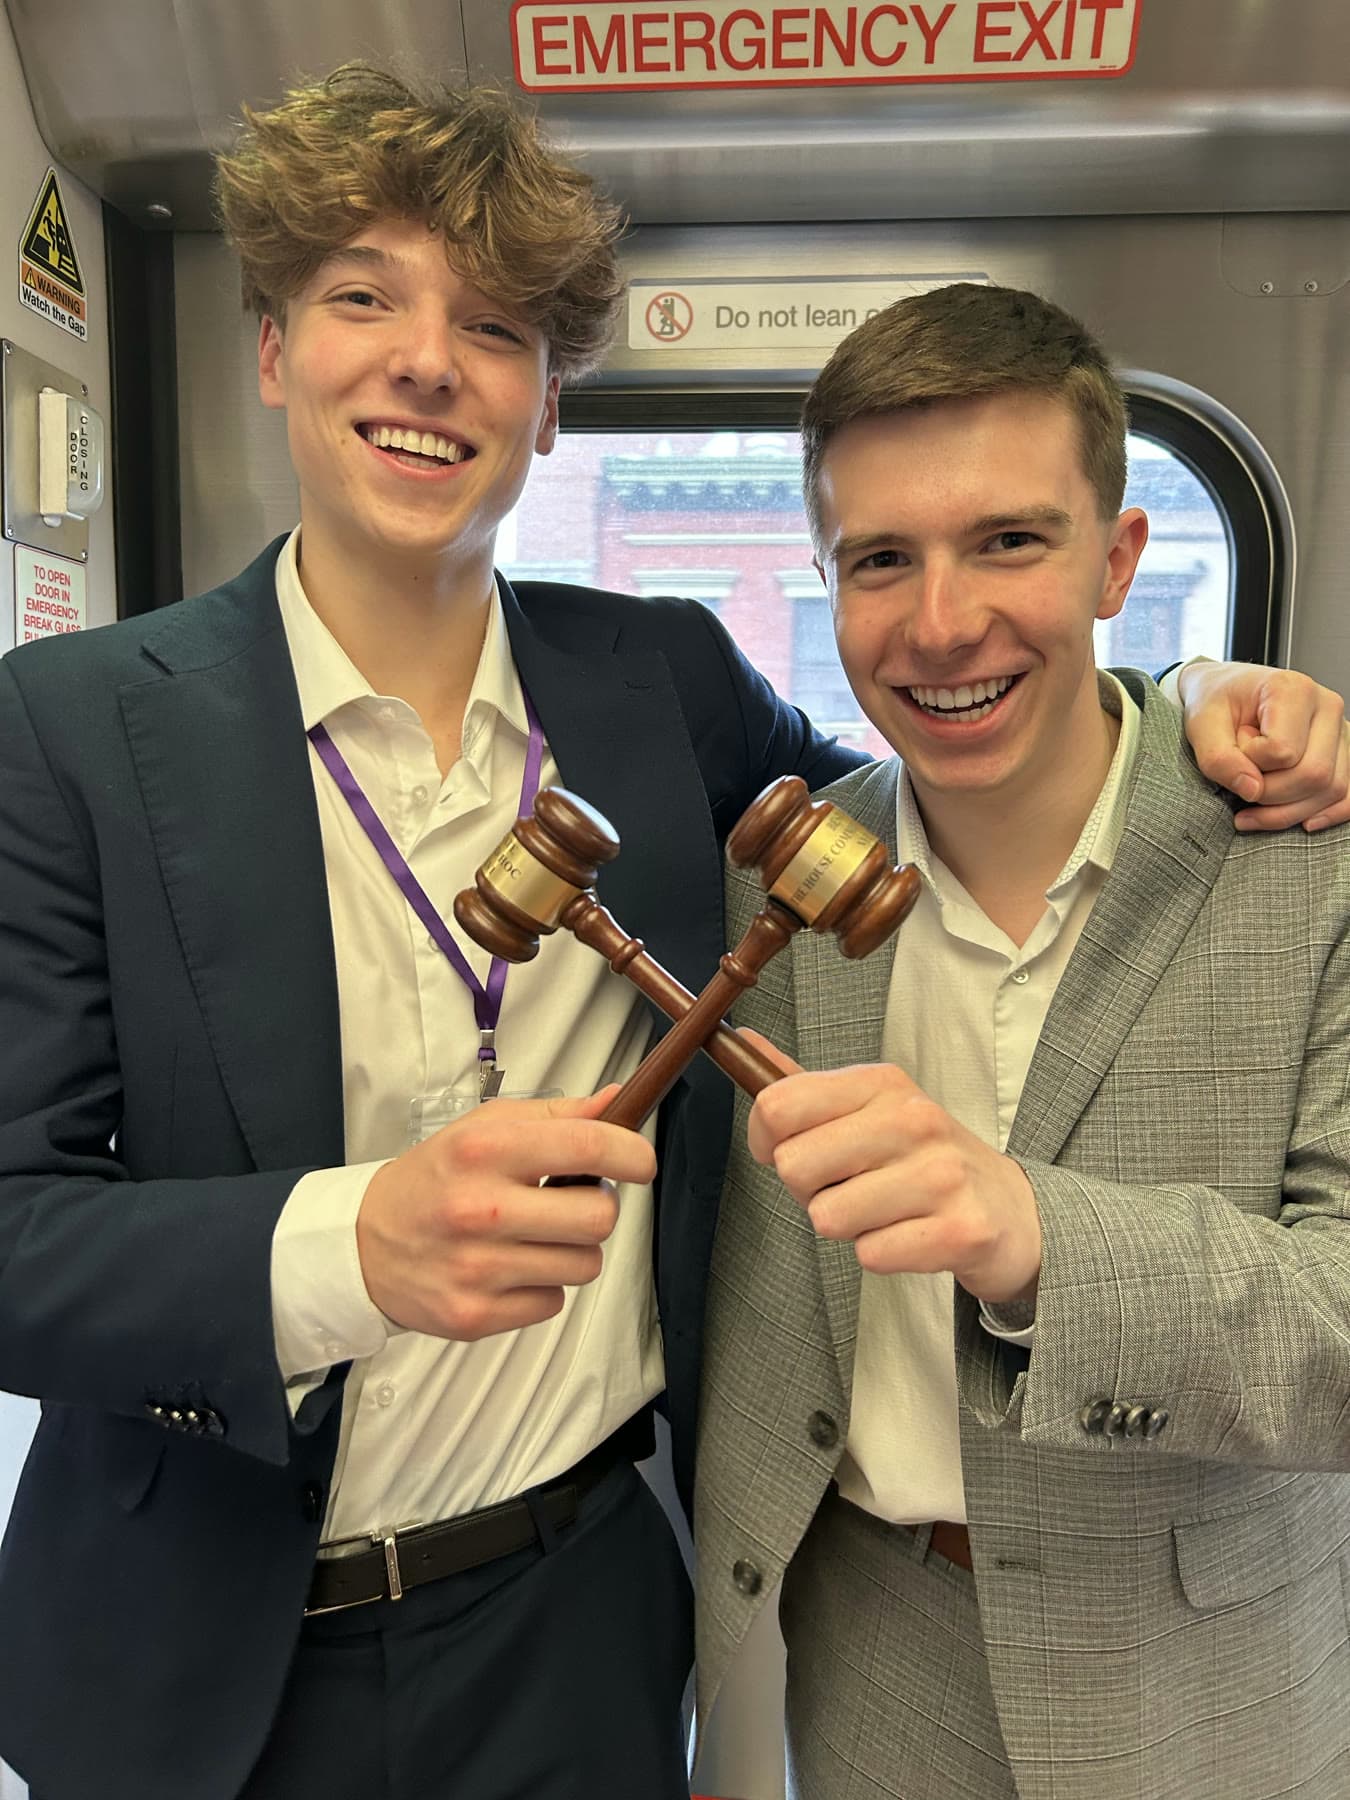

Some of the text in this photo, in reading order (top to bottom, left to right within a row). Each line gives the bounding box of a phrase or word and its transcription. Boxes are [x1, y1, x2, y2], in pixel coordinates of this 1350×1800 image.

[532, 0, 1124, 75] EMERGENCY EXIT
[22, 285, 86, 337] Watch the Gap
[37, 275, 80, 314] WARNING
[715, 305, 750, 329] Do
[758, 305, 798, 328] not
[805, 304, 857, 327] lean
[70, 432, 78, 475] DOOR
[80, 415, 88, 491] CLOSING
[34, 564, 71, 586] TO OPEN
[35, 582, 71, 603] DOOR IN
[23, 613, 53, 632] BREAK
[26, 597, 80, 620] EMERGENCY
[802, 853, 834, 891] HOUSE
